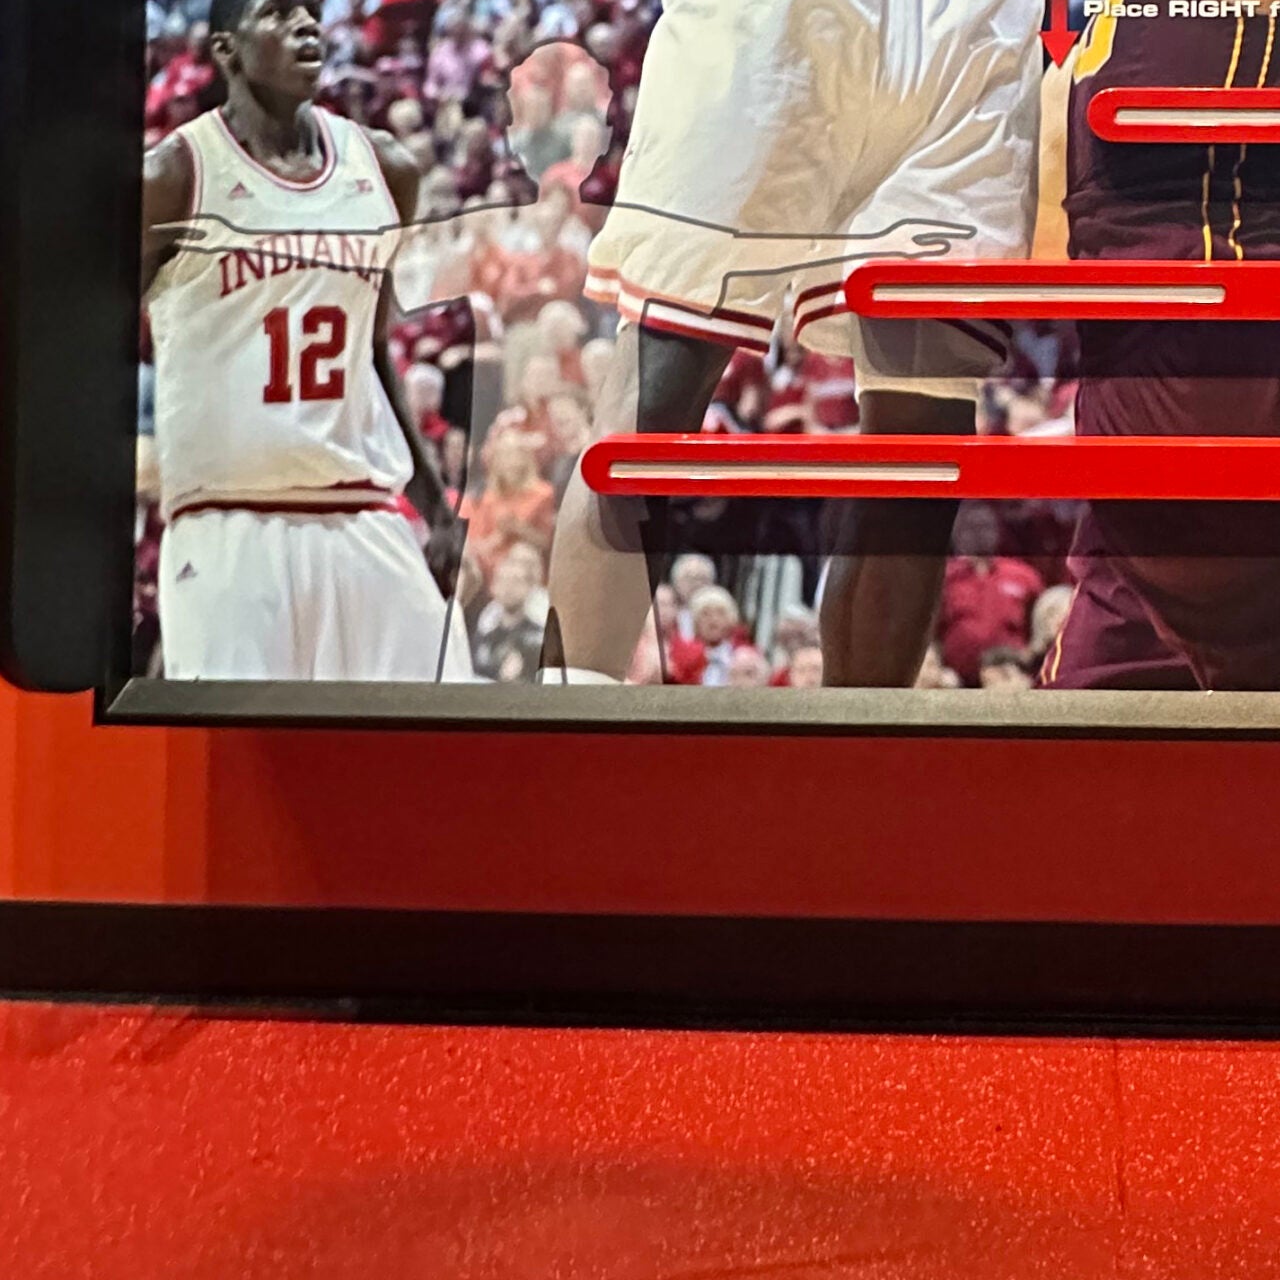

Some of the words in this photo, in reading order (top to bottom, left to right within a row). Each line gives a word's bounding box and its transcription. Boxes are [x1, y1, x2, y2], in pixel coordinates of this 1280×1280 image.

[1083, 0, 1159, 18] Place
[1170, 0, 1262, 18] RIGHT
[262, 304, 348, 404] 12
